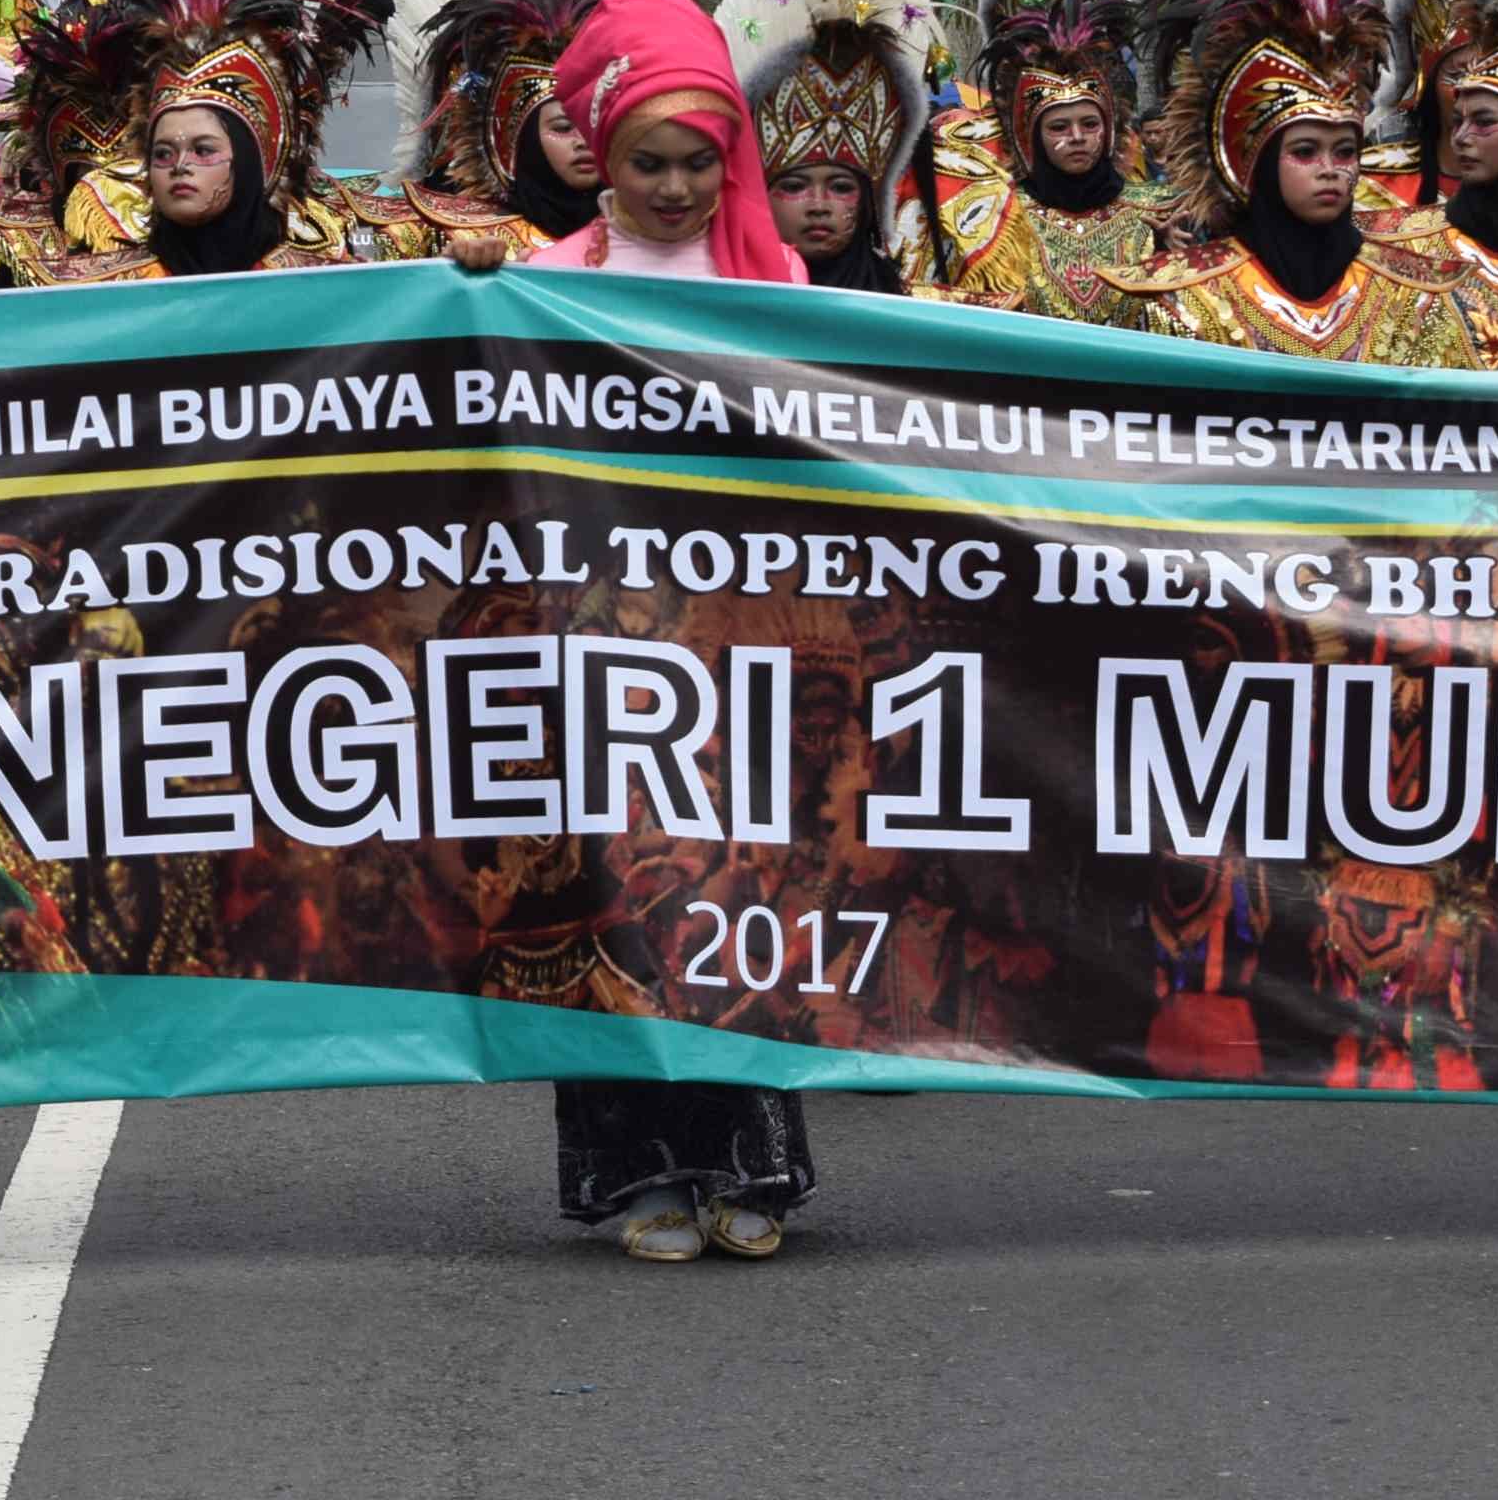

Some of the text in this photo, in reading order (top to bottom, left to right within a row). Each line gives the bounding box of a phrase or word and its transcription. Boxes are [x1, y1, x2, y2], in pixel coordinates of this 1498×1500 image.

[160, 372, 432, 446] BUDAYA
[454, 369, 729, 434] BANGSA
[753, 386, 1042, 454] MELALUI
[608, 524, 1007, 601] TOPENG
[1032, 541, 1358, 614] IRENG
[864, 650, 1031, 852] 1
[684, 899, 891, 996] 2017
